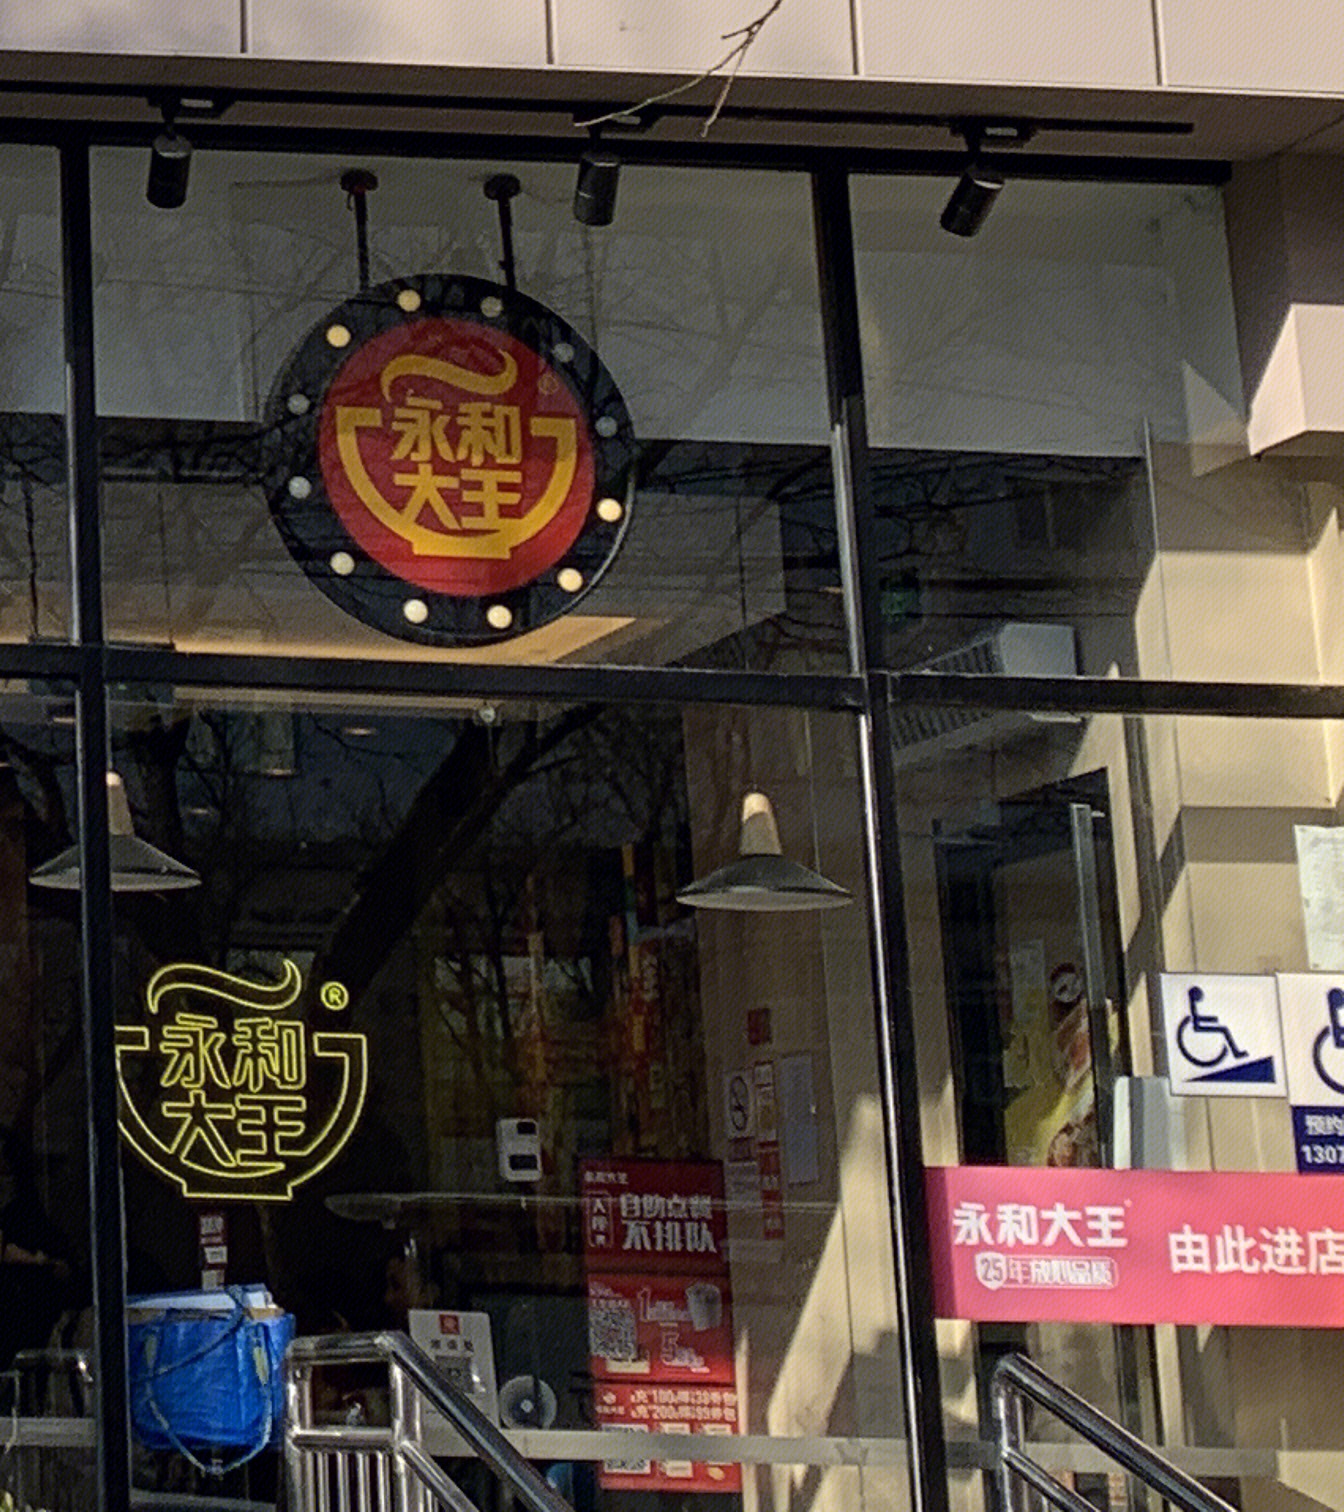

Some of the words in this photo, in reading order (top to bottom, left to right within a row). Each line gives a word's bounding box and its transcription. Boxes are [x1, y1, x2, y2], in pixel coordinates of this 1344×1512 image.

[391, 395, 523, 467] 永和
[393, 463, 524, 530] 大王
[160, 1012, 308, 1093] 永和
[161, 1089, 308, 1171] 大王
[621, 1219, 717, 1254] 不排队
[952, 1200, 1129, 1248] 永和大王
[1167, 1223, 1344, 1276] 由此进店
